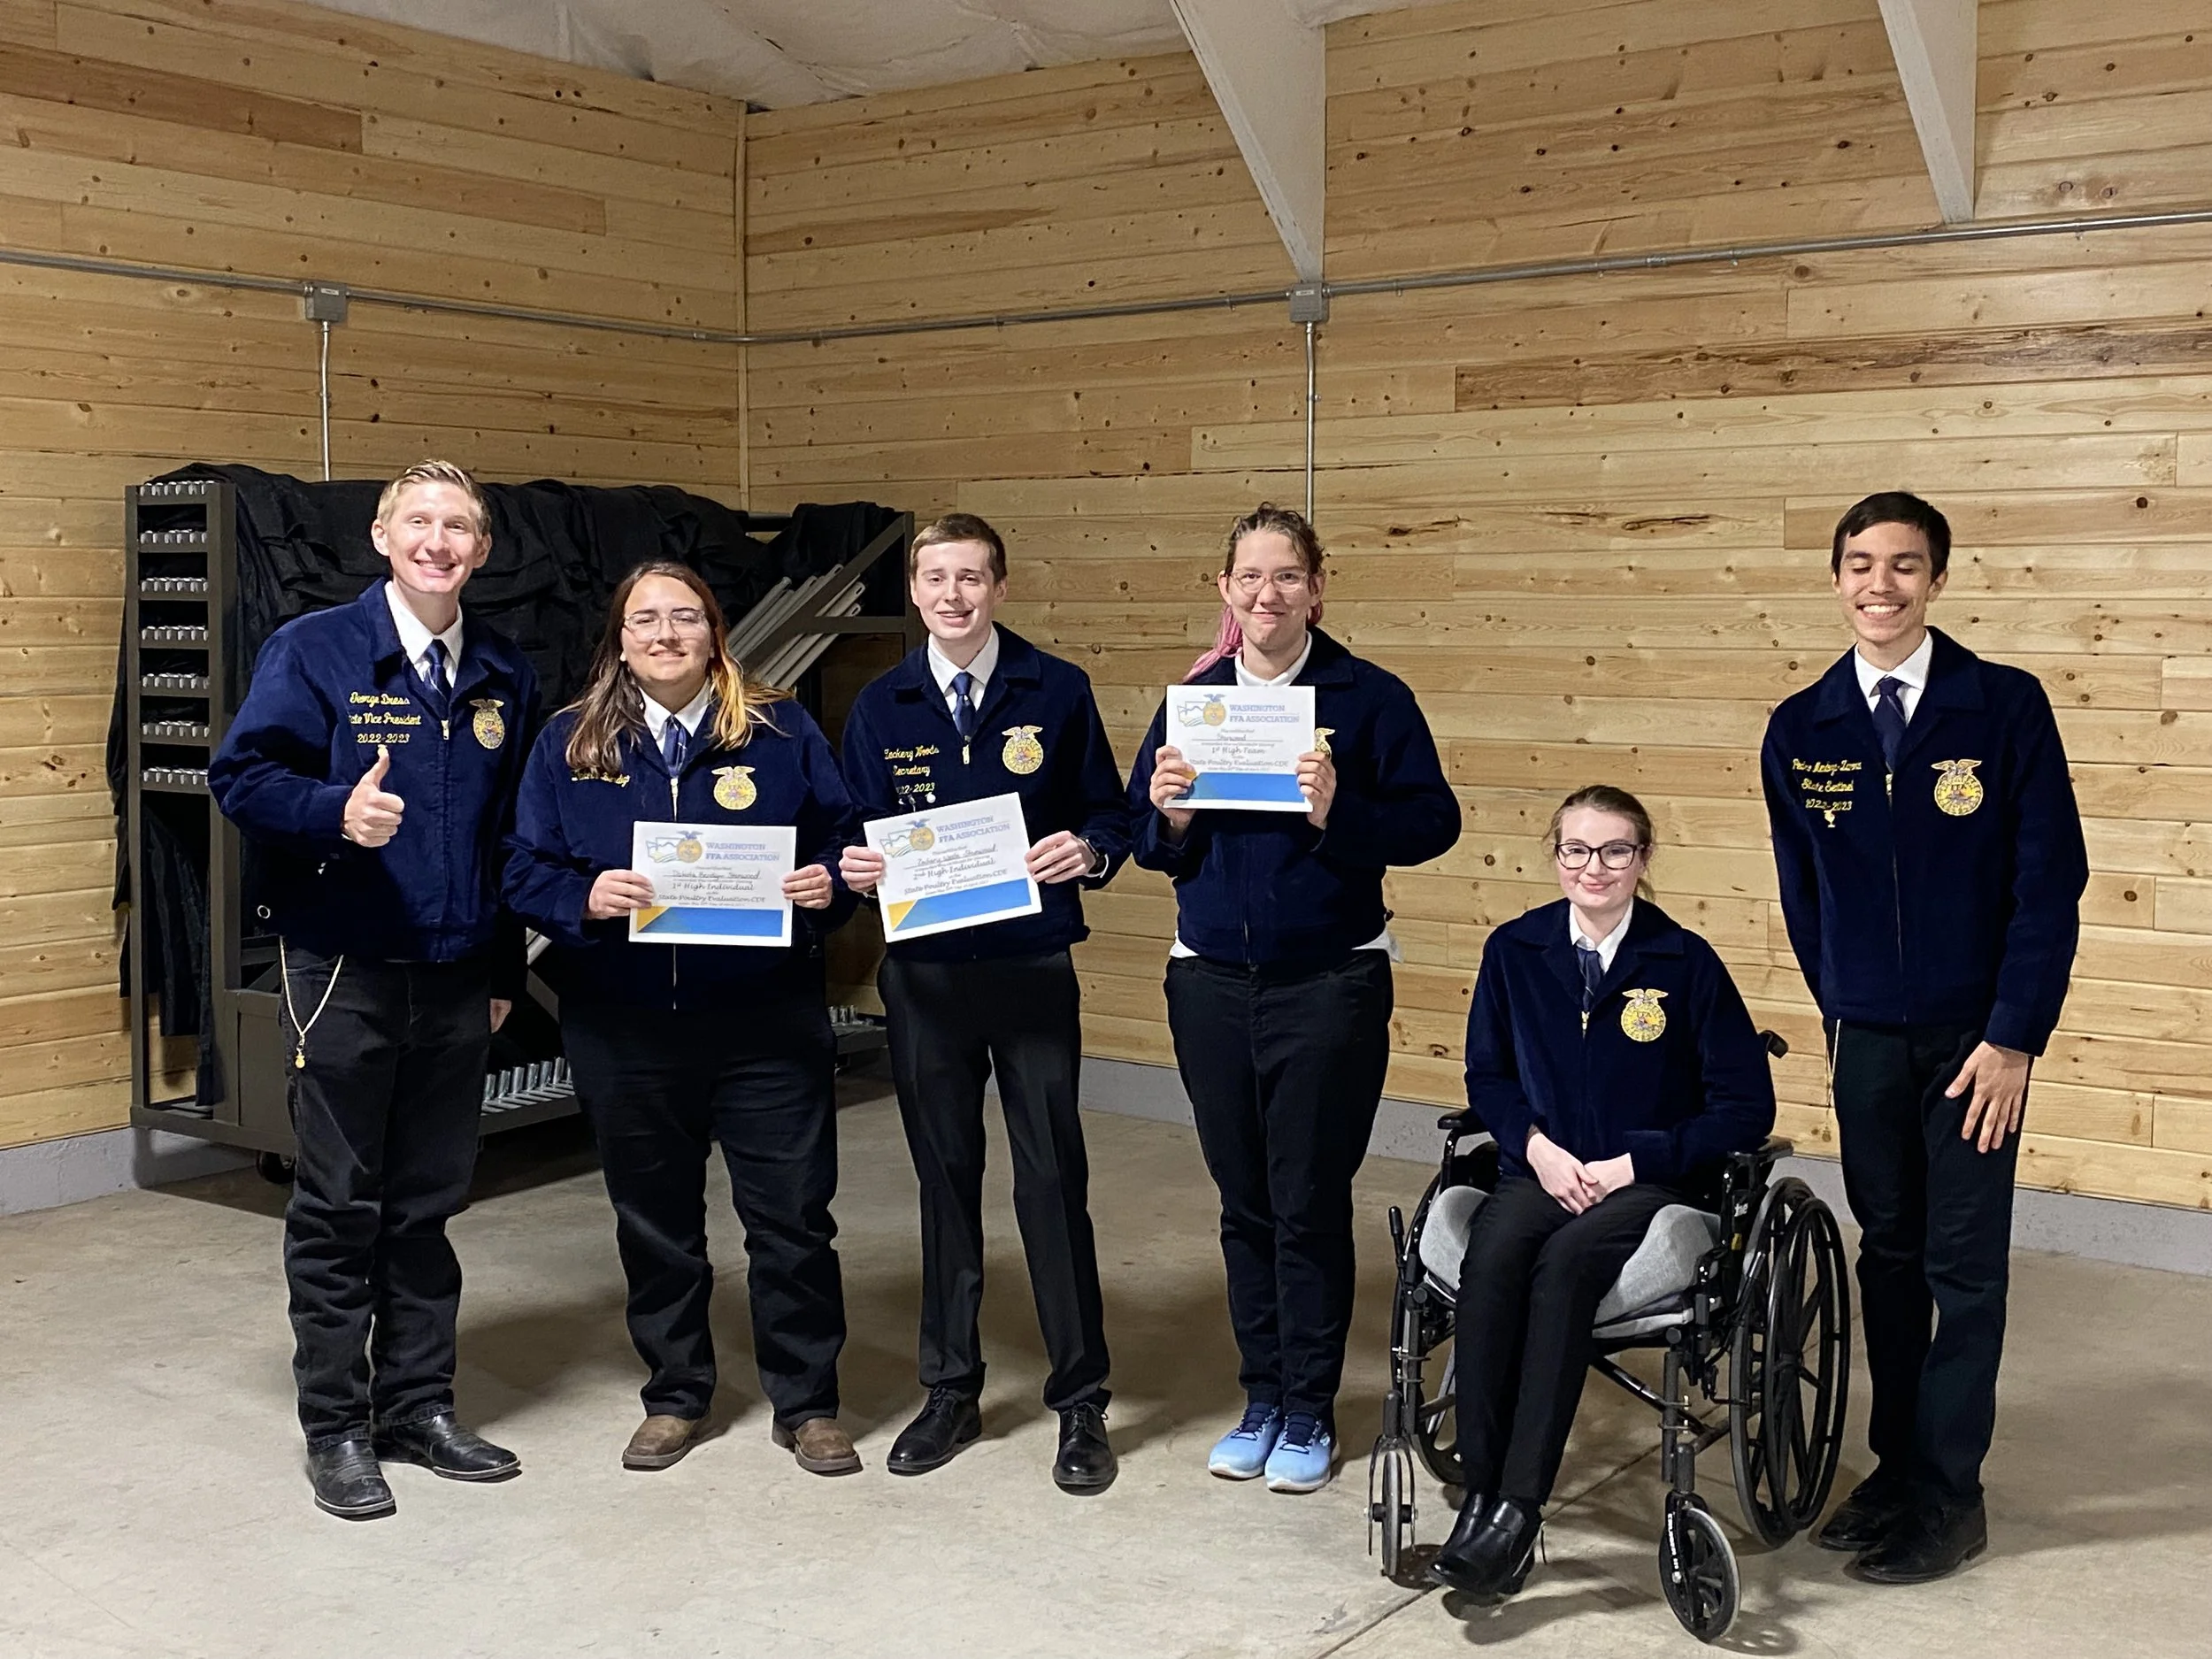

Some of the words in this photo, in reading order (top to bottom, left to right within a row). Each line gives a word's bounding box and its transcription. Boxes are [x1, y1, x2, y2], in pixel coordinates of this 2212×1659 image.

[349, 691, 380, 708] George
[1229, 703, 1286, 712] WASHINGTON
[363, 712, 382, 724] Vice
[383, 711, 422, 725] President
[357, 733, 411, 743] 2022-2023
[1222, 747, 1241, 757] High
[893, 764, 931, 777] Secretary
[936, 815, 994, 833] WASHINGTON
[939, 833, 955, 843] FFA
[955, 823, 1010, 841] ASSOCIATION
[705, 841, 765, 851] WASHINGTON
[724, 853, 780, 862] ASSOCIATION
[927, 866, 948, 879] High
[949, 857, 996, 873] Individual
[684, 882, 704, 892] High
[707, 883, 754, 892] Individual
[904, 885, 923, 895] State
[924, 879, 950, 891] Poultry
[951, 873, 993, 886] Evaluation
[679, 894, 707, 902] Poultry
